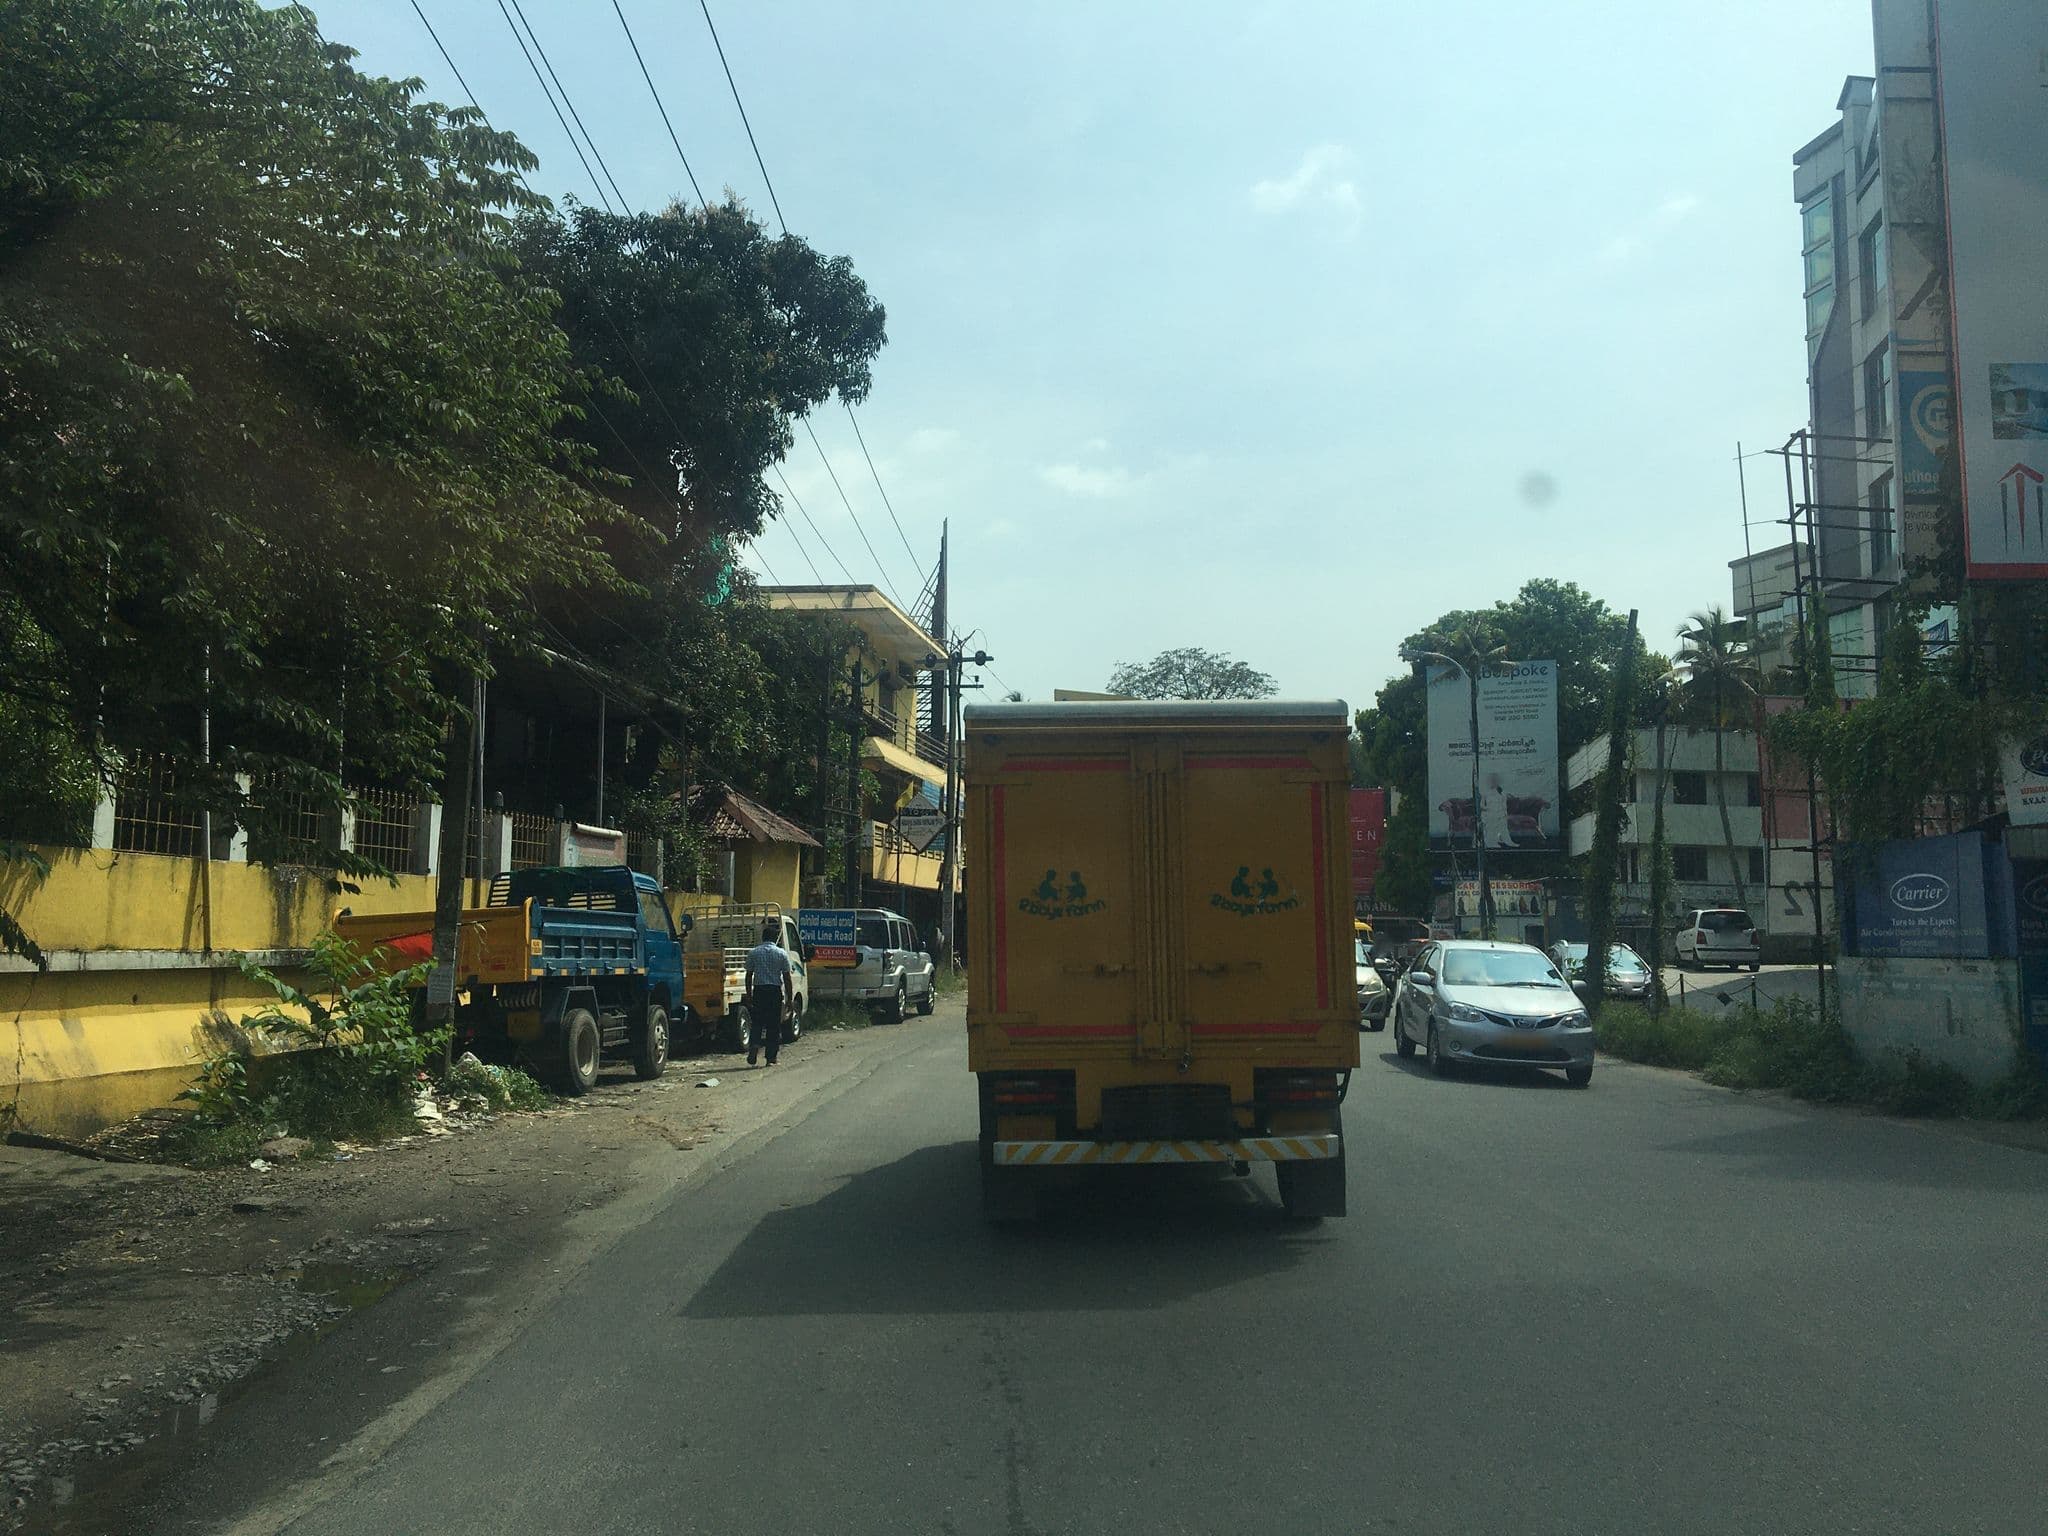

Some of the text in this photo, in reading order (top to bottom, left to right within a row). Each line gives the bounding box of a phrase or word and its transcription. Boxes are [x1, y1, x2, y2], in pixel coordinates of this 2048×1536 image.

[1896, 885, 1943, 902] Carrier
[799, 929, 853, 941] Civil Line Road
